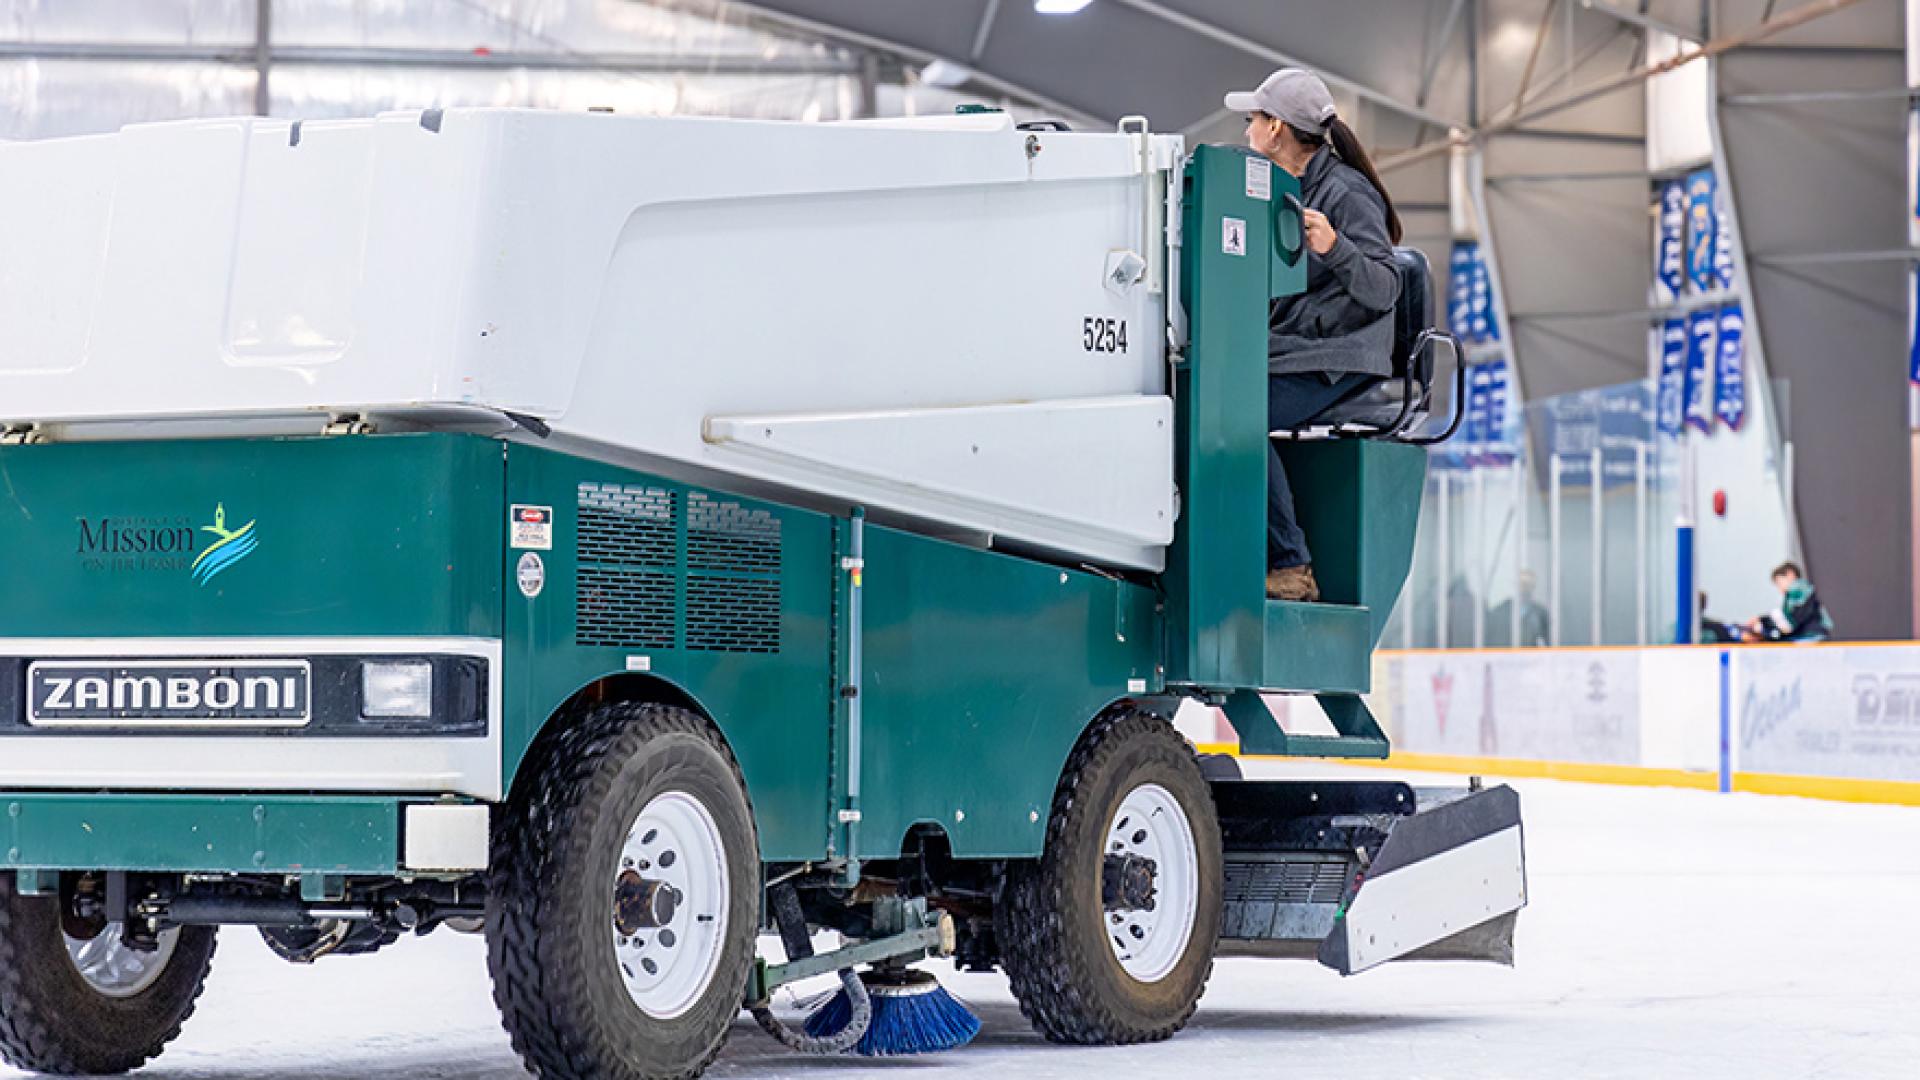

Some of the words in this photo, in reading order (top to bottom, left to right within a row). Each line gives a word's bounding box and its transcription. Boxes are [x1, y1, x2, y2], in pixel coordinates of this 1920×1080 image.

[1083, 316, 1128, 354] 5254
[78, 518, 194, 553] Mission
[43, 677, 296, 709] ZAMBONI
